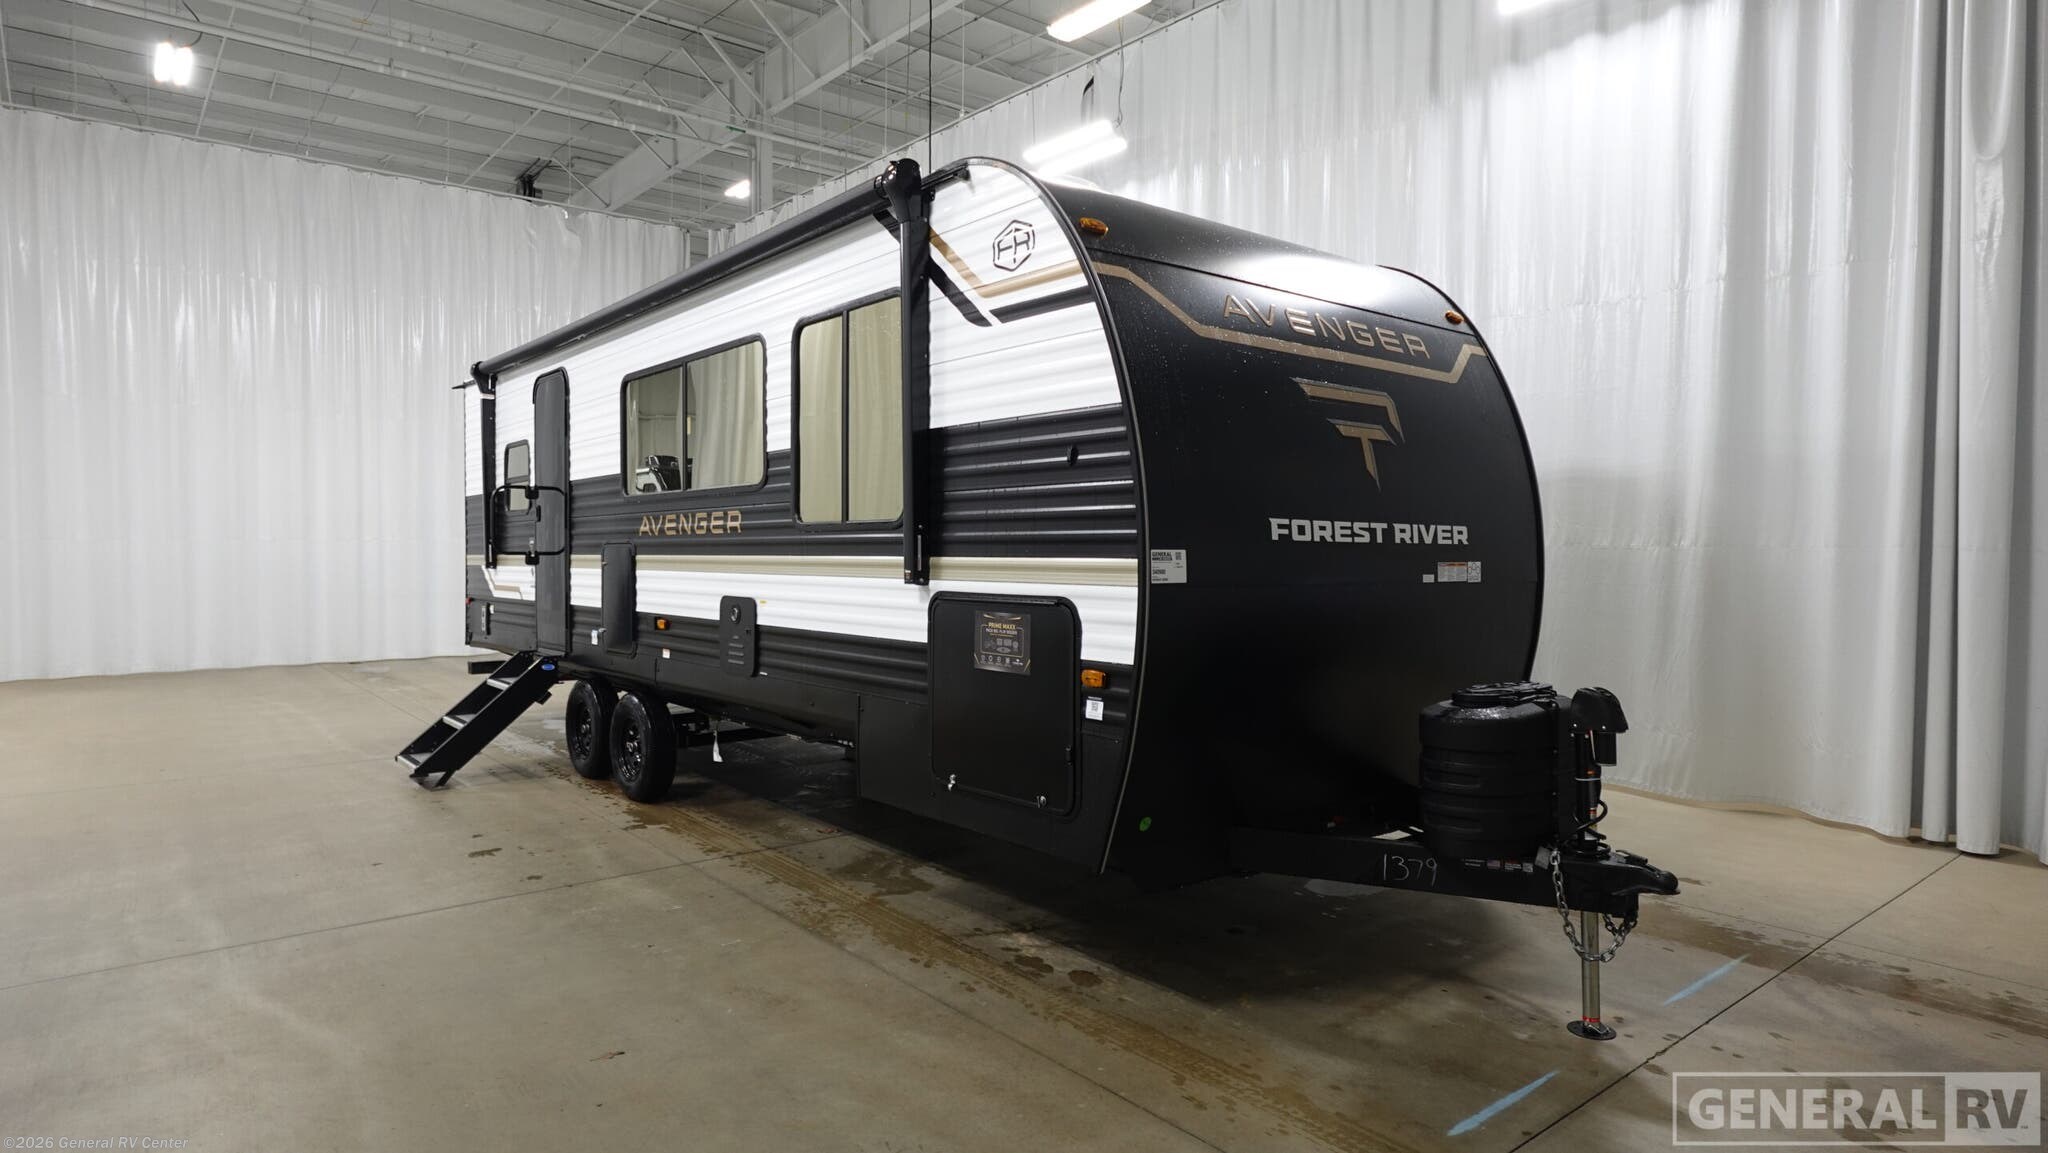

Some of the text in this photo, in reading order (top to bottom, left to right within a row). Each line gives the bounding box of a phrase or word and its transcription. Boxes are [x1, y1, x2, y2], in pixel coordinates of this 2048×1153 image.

[1223, 294, 1431, 359] AVENGER
[639, 510, 742, 536] AVENGER
[1268, 517, 1469, 545] FOREST RIVER
[1383, 853, 1438, 887] 1379
